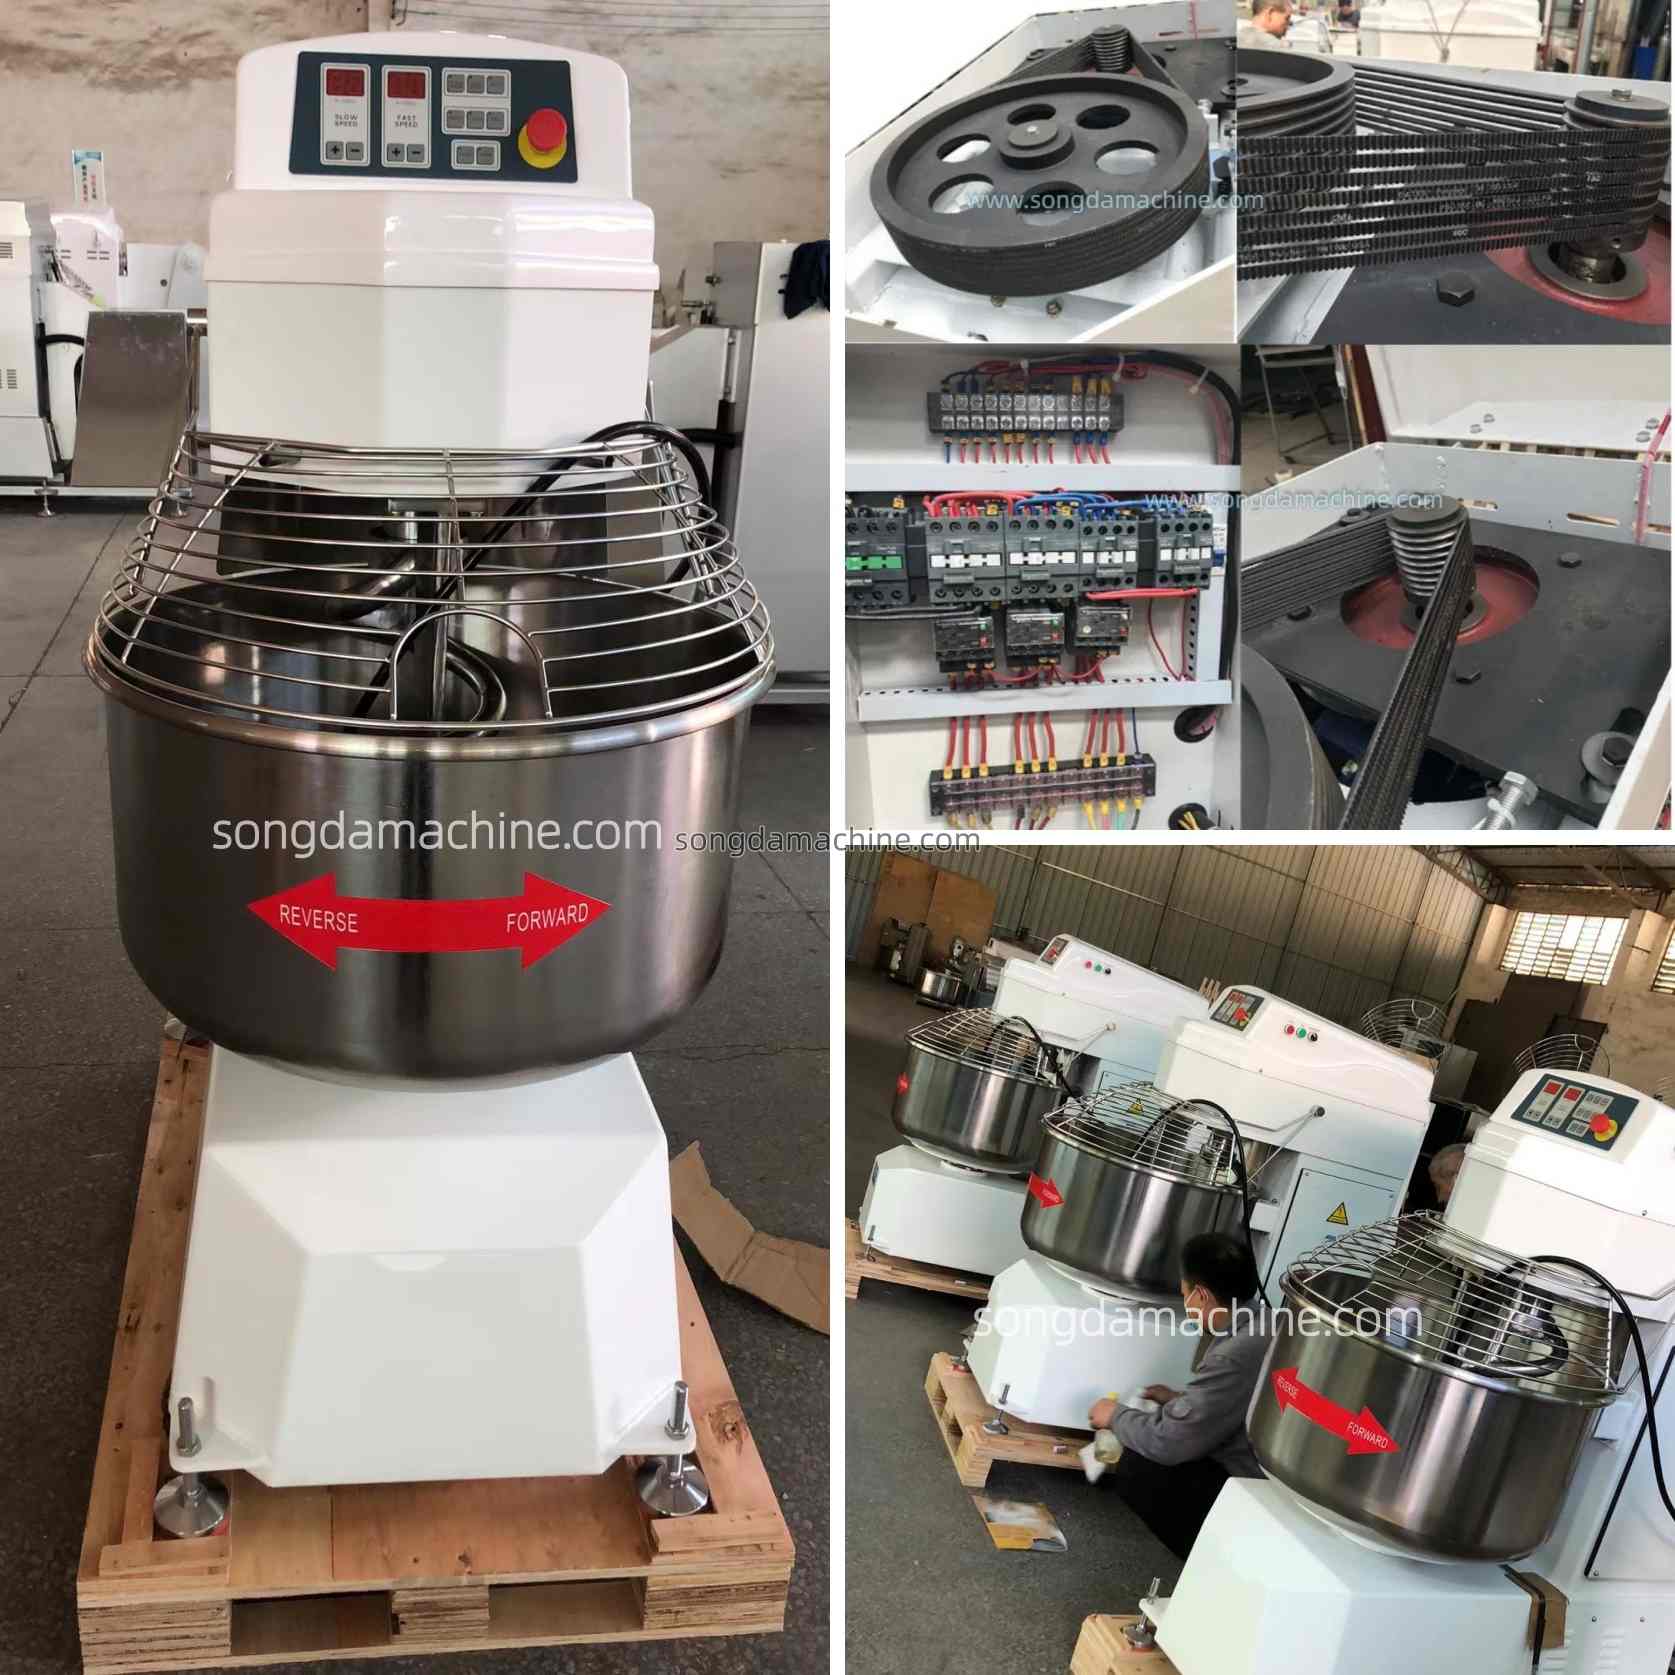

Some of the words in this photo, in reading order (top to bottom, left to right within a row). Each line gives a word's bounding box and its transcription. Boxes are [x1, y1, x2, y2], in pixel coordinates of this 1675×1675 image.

[334, 120, 359, 128] SPEED
[279, 903, 359, 934] REVERSE
[505, 901, 590, 934] FORWARD
[1346, 1421, 1389, 1449] FORWARD
